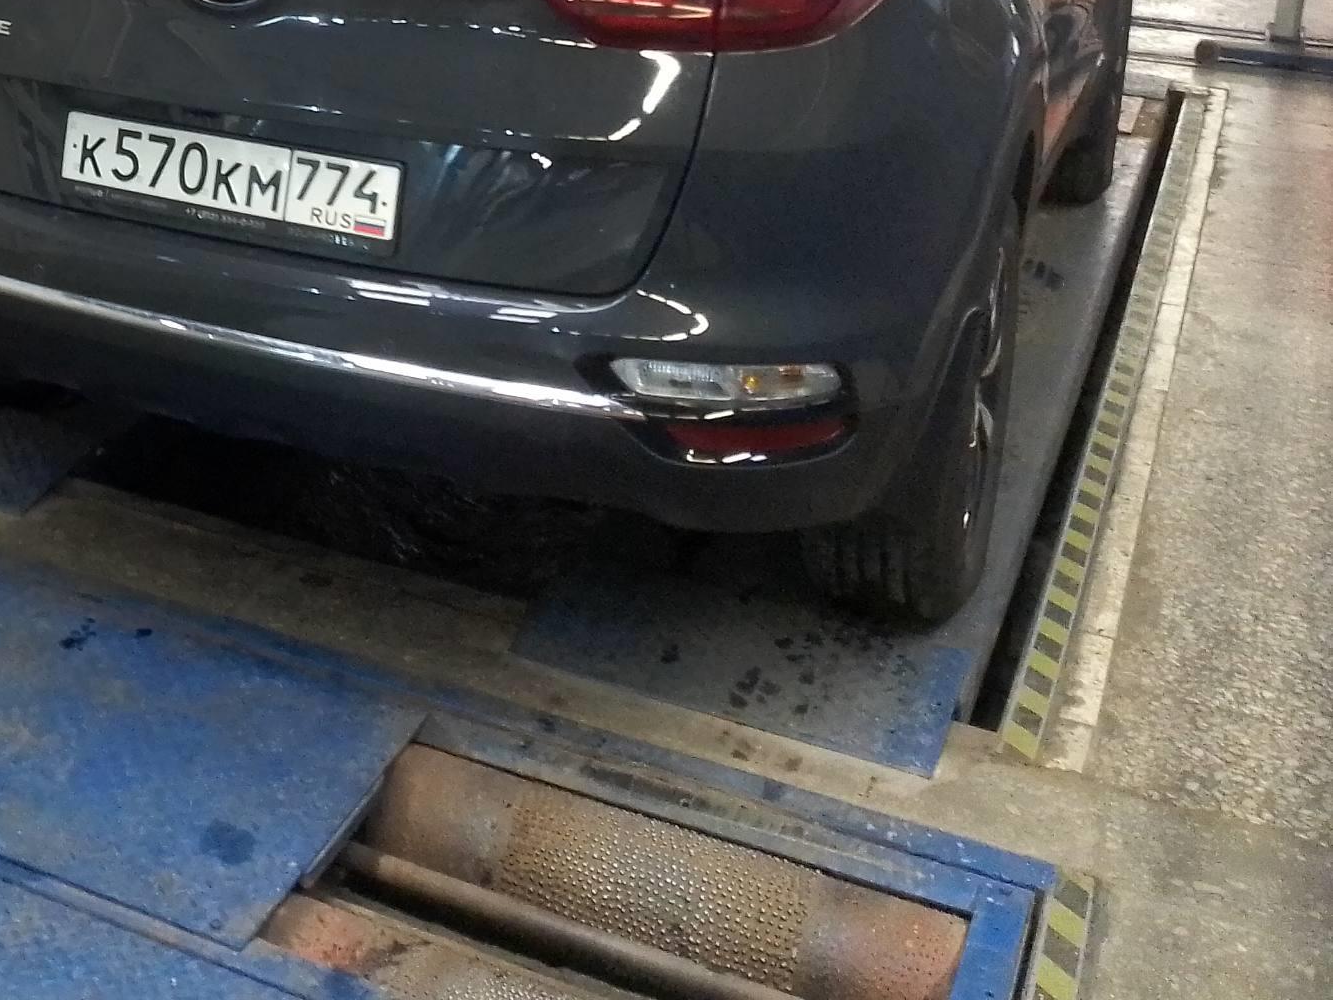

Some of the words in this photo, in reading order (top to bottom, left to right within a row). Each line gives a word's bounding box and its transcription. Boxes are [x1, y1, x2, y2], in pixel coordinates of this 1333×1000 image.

[78, 127, 283, 212] К570КМ
[296, 156, 378, 214] 774
[310, 207, 352, 229] RUS
